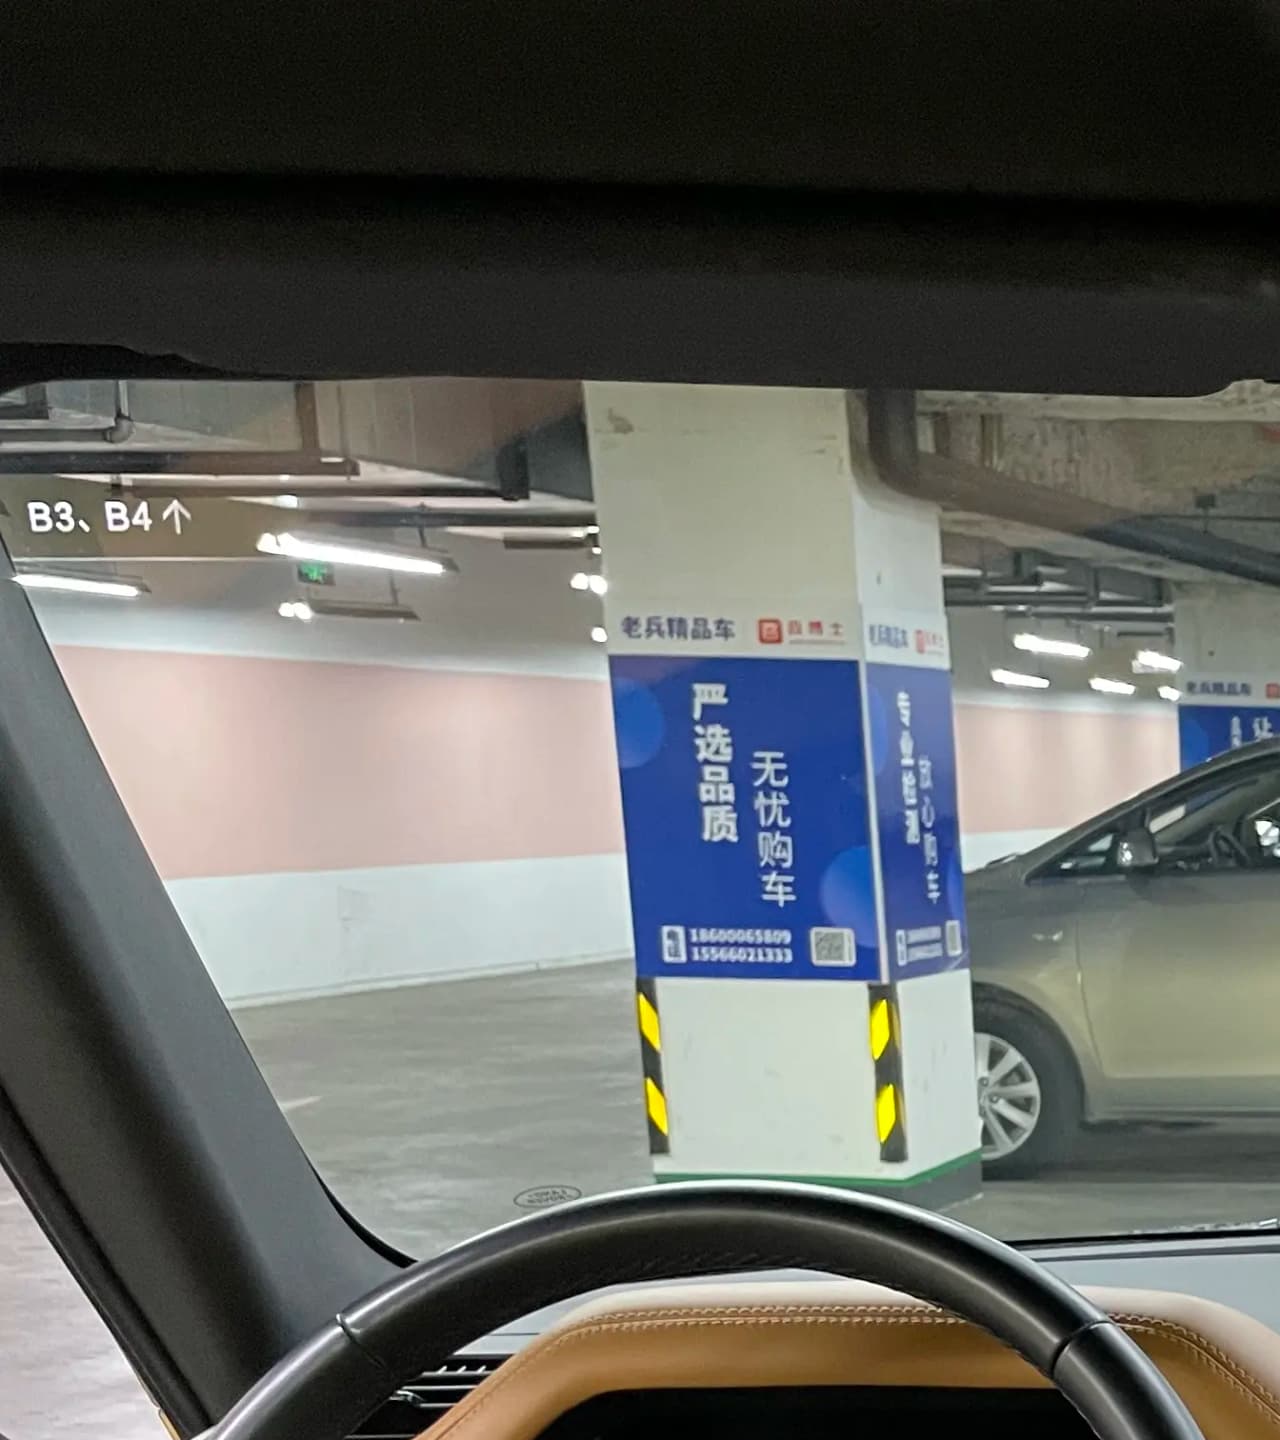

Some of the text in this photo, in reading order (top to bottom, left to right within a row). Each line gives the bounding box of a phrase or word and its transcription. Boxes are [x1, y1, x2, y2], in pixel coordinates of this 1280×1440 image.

[621, 616, 736, 641] 老兵精品车
[691, 683, 739, 843] 严选品质
[751, 751, 797, 908] 无忧购车
[689, 928, 791, 945] 18600065809
